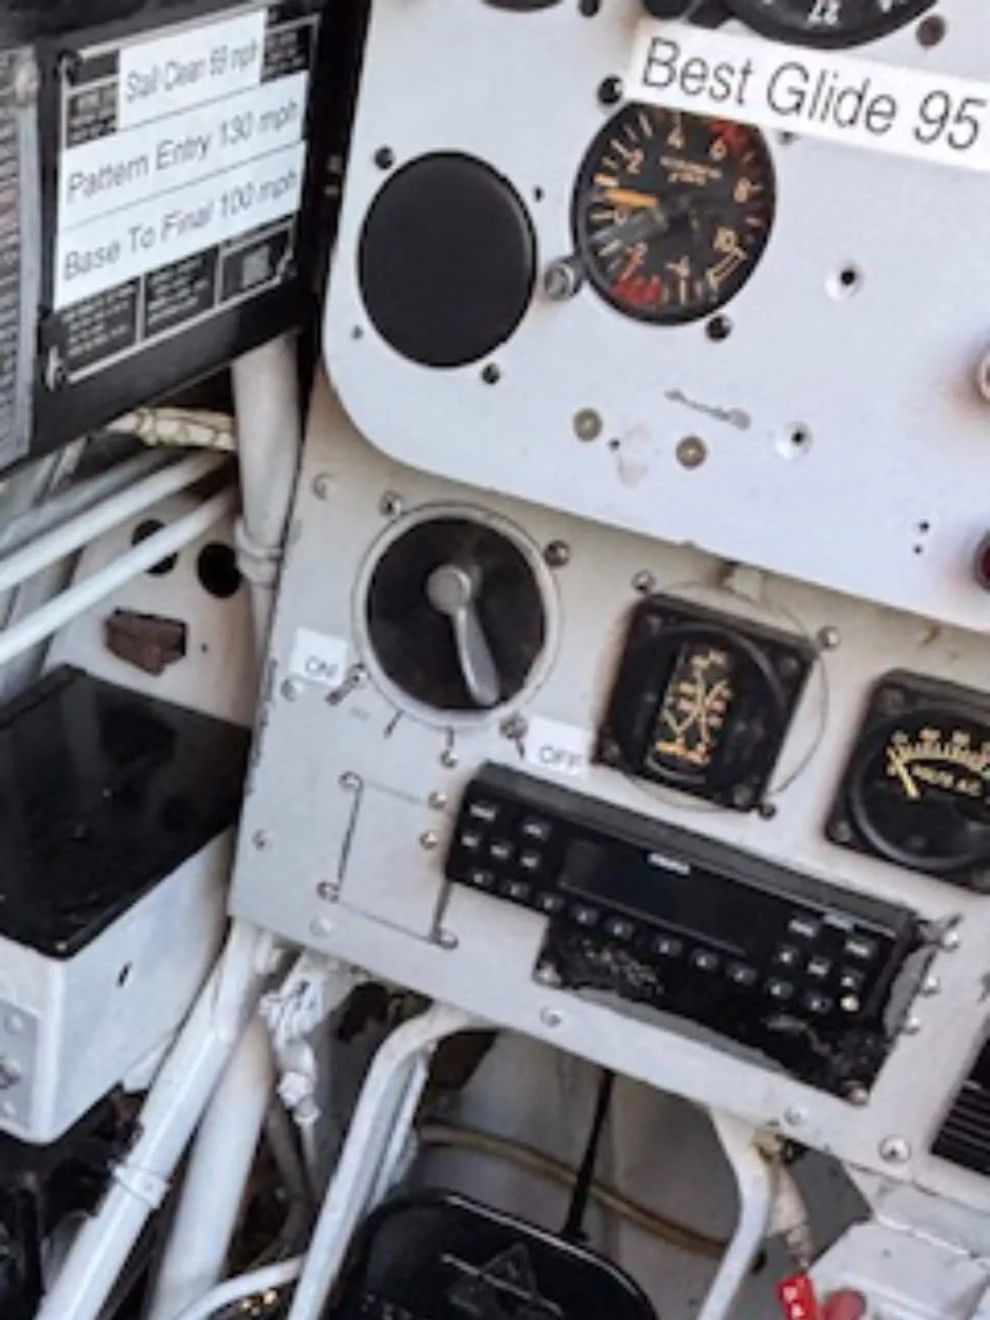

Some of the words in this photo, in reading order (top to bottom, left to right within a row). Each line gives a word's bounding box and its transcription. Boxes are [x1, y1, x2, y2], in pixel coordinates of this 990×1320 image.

[642, 36, 755, 105] Best
[767, 61, 898, 136] Glide
[914, 89, 989, 151] 95
[67, 153, 150, 202] Pattern
[156, 131, 214, 171] Entry
[219, 110, 254, 147] 130
[259, 98, 299, 135] mph
[63, 241, 122, 282] Base
[128, 221, 157, 254] To
[161, 199, 215, 242] Final
[220, 179, 255, 218] 100
[259, 168, 299, 204] mph
[305, 656, 338, 678] ON
[539, 743, 585, 772] OFF
